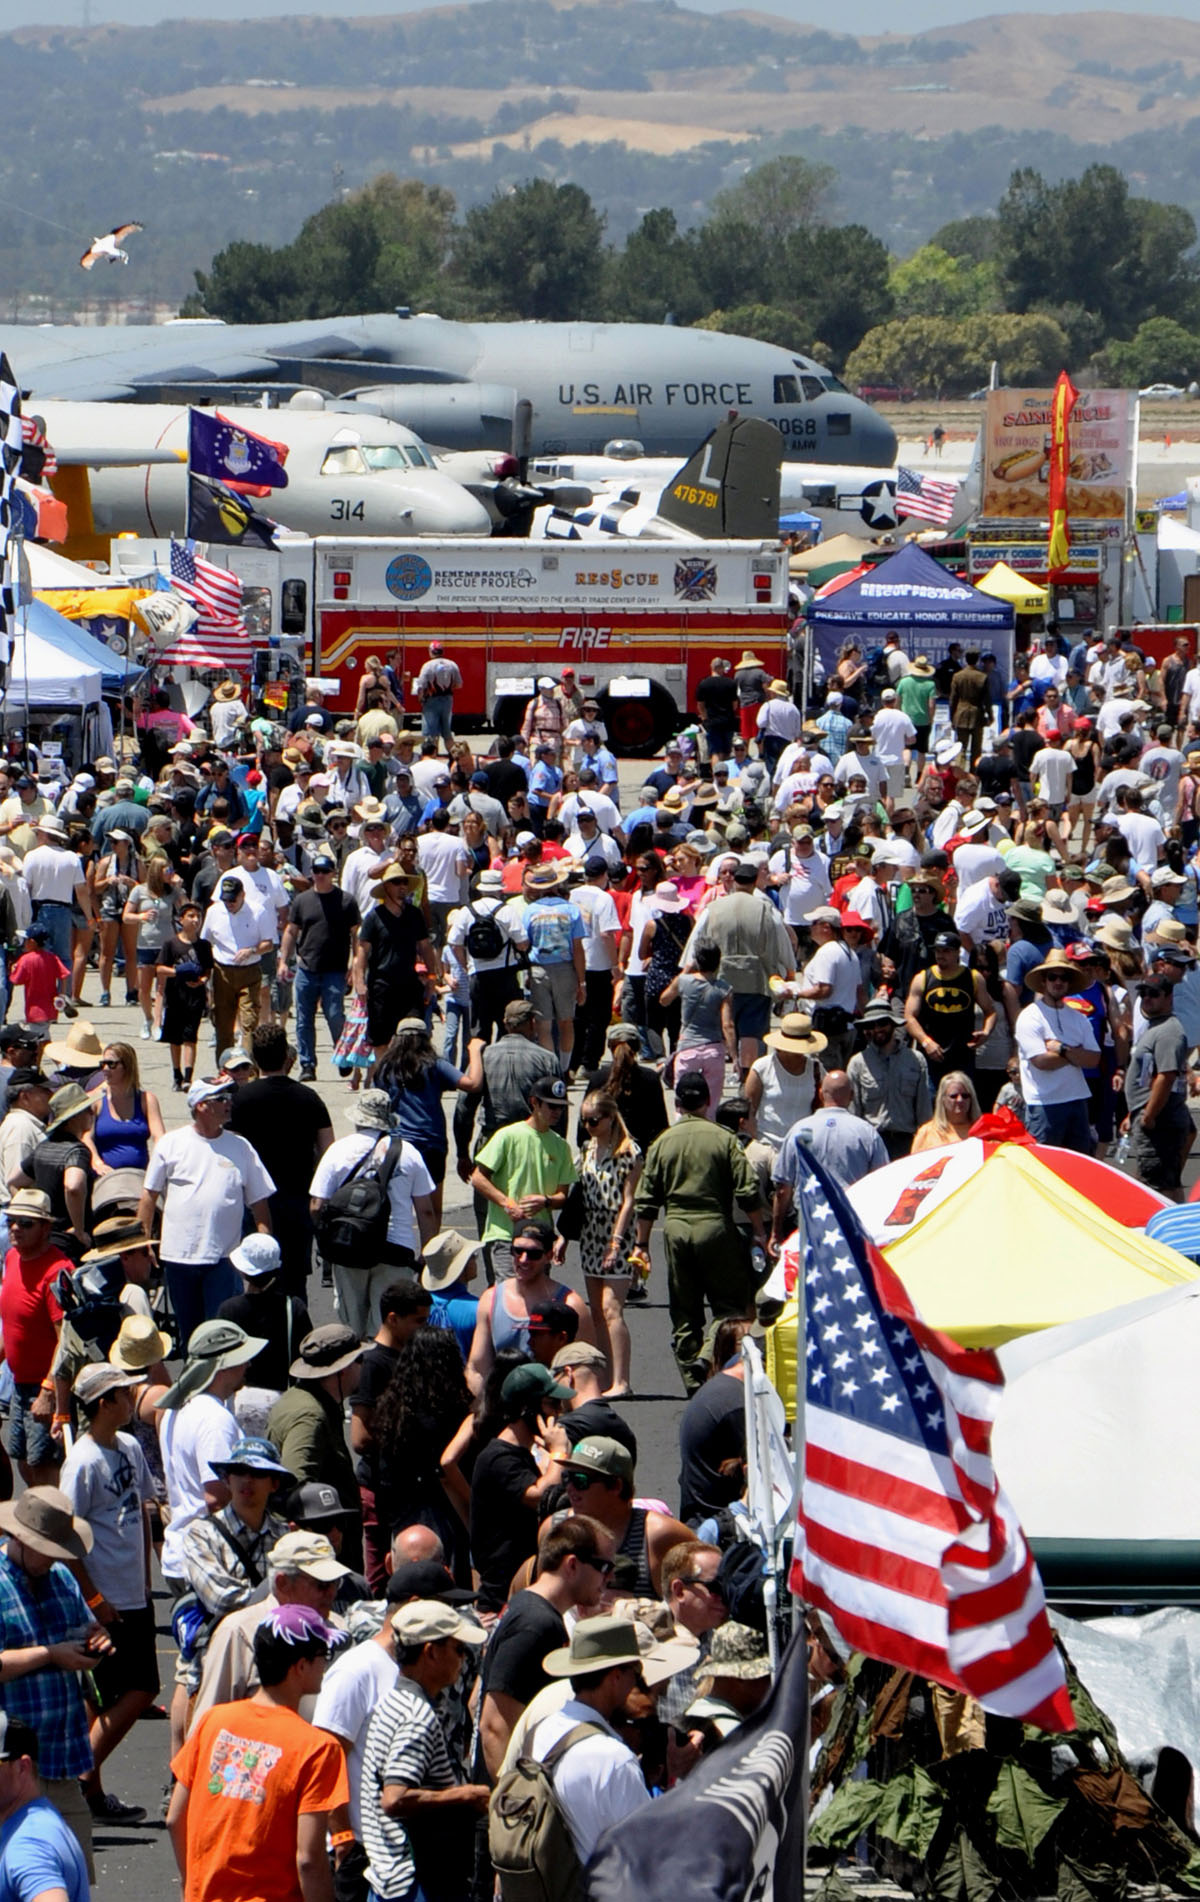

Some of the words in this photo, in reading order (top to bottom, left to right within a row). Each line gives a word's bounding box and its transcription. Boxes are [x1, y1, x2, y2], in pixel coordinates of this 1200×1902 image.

[559, 384, 606, 406] U.S.
[614, 384, 653, 405] AIR
[665, 383, 753, 406] FORCE
[1003, 408, 1112, 427] SANDICH
[699, 443, 721, 488] L
[674, 484, 719, 509] 476791
[330, 499, 365, 521] 314
[434, 570, 516, 578] REMEMBRANCE
[434, 578, 477, 588] RESCUE
[481, 578, 532, 588] PROJECT
[558, 627, 611, 648] FIRE
